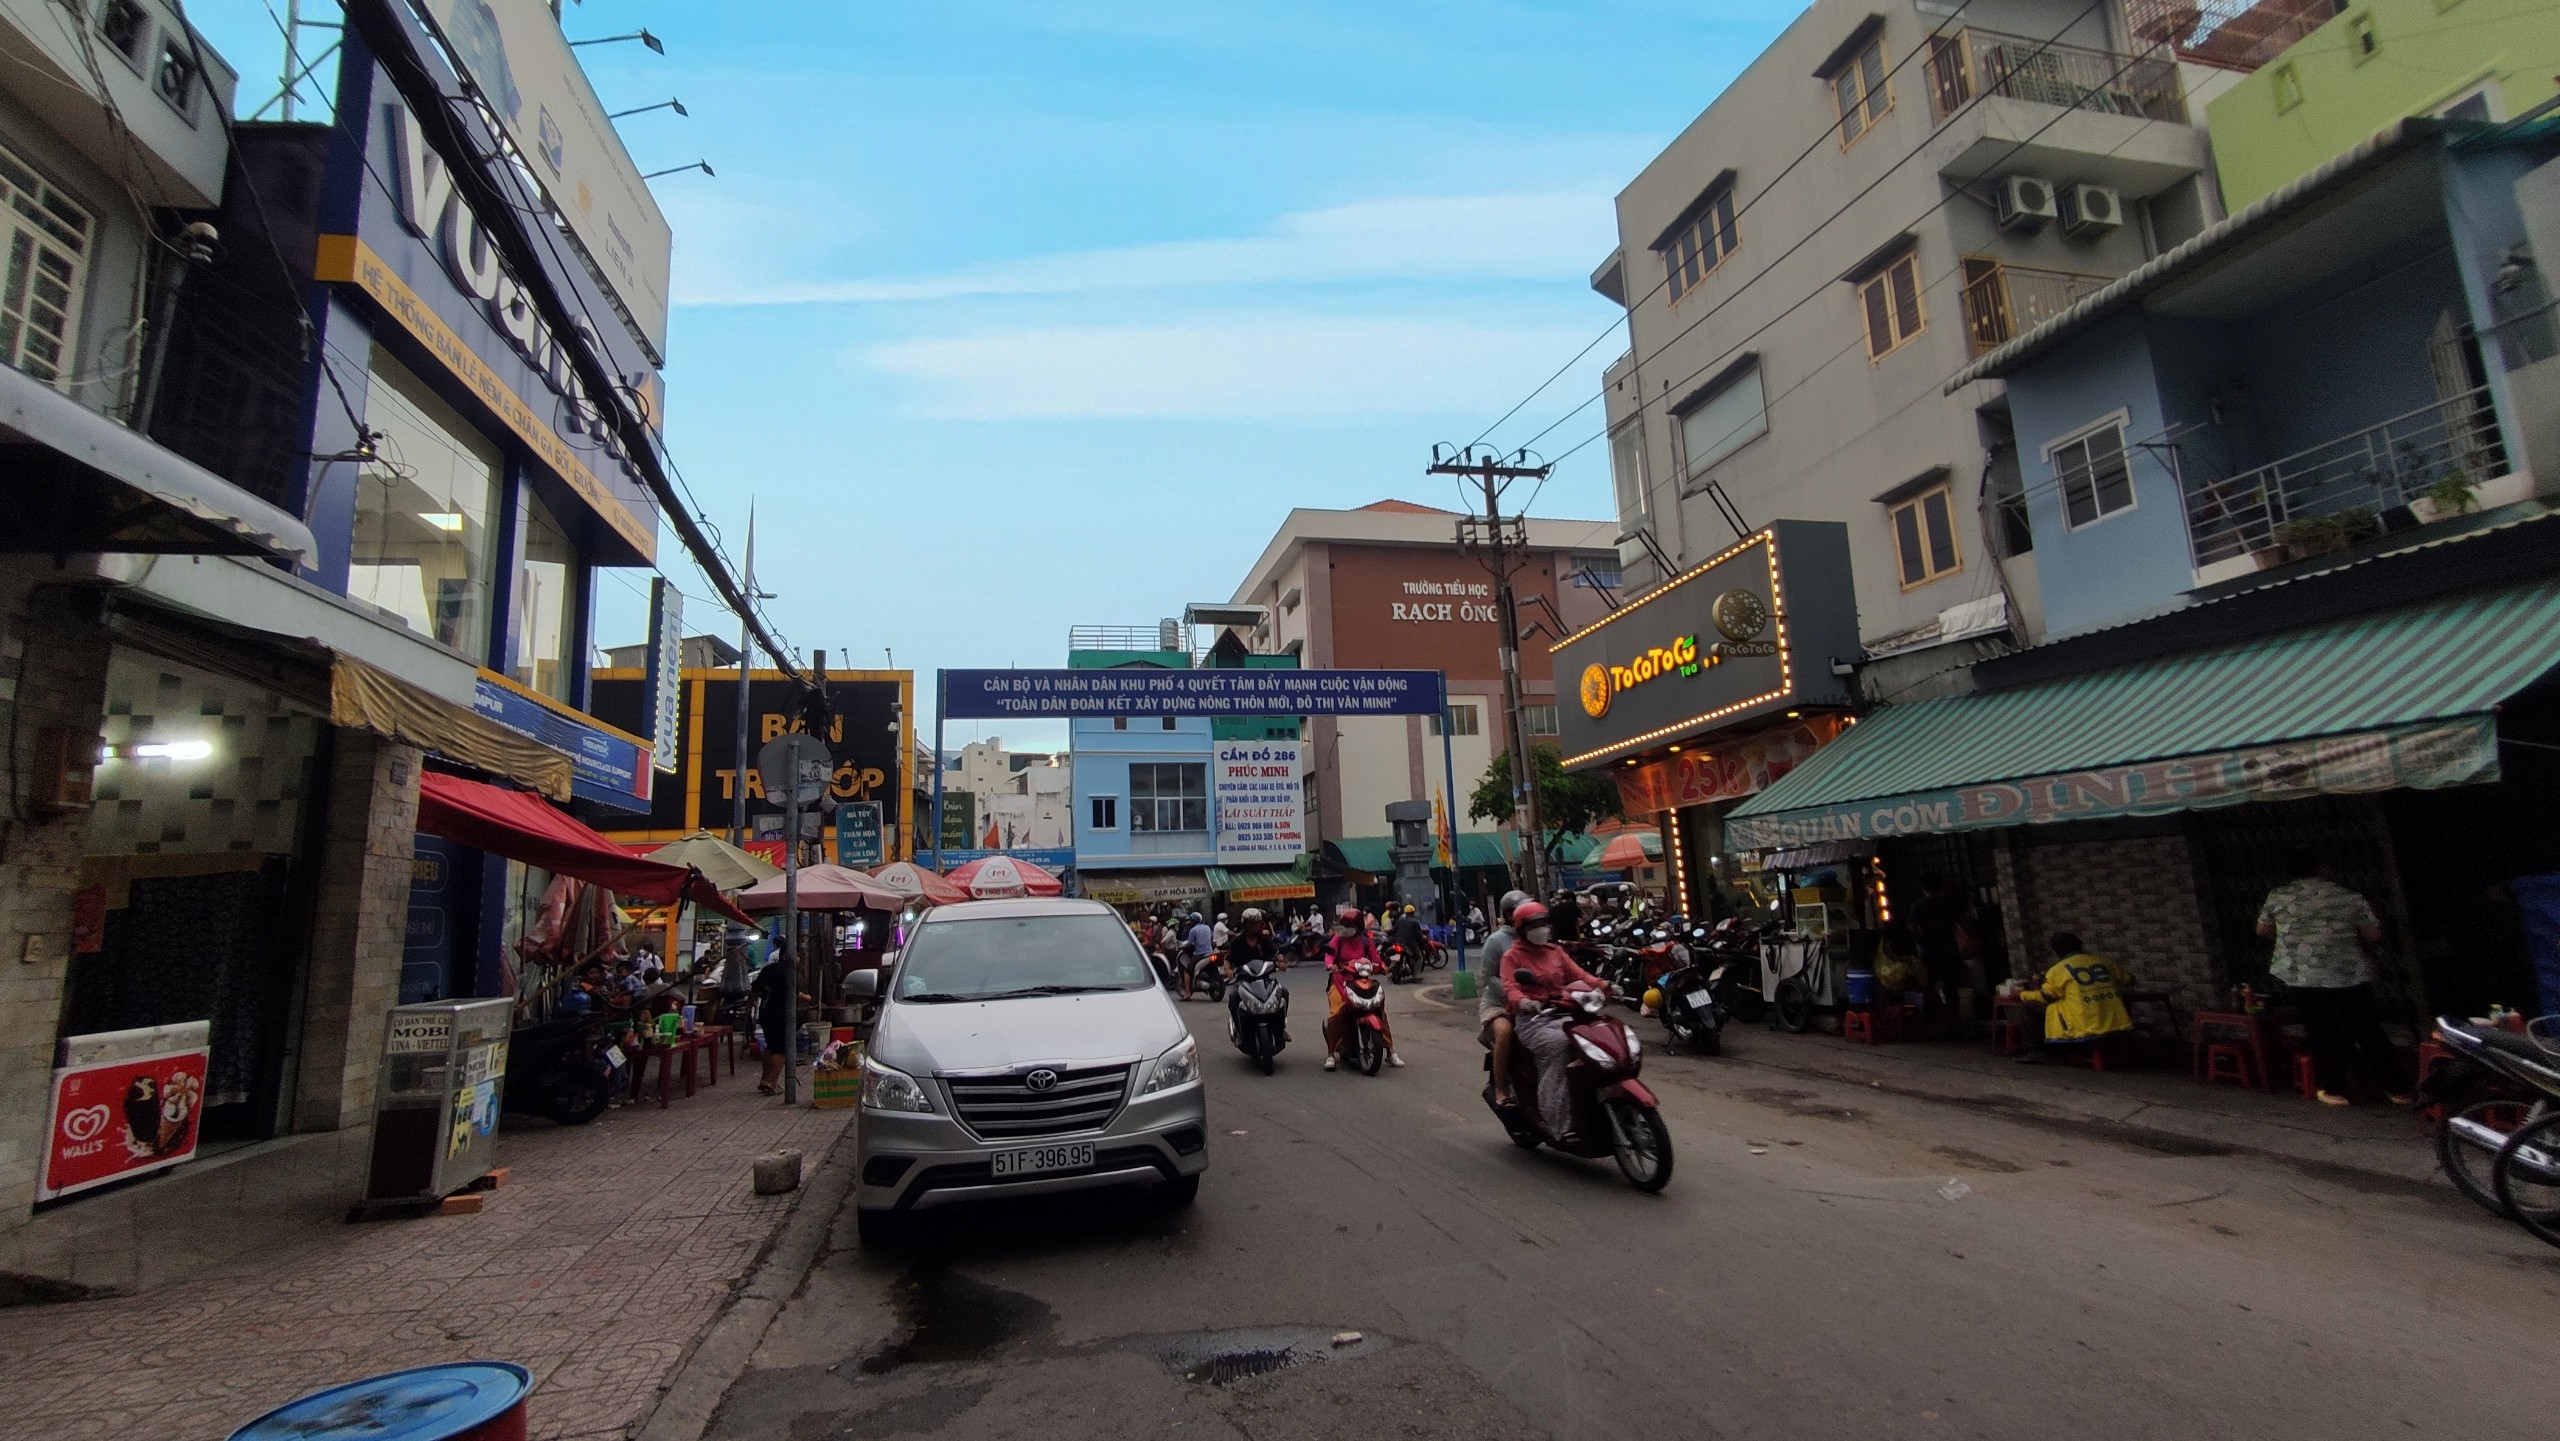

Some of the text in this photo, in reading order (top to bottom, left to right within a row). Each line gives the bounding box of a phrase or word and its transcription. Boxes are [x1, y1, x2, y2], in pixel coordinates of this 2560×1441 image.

[436, 330, 462, 370] BÁN
[1403, 578, 1488, 600] TRƯỜNG TIỂU HỌC
[1391, 600, 1498, 625] RẠCH ÔNG
[1679, 662, 1698, 678] Tea
[984, 673, 1408, 694] CÁN BỘ VÀ NHÂN DÂN KHU PHỐ 4 QUYẾT TÂM ĐẨY MẠNH CUỘC VẬN ĐỘNG
[1041, 696, 1066, 710] DÂN
[1070, 695, 1105, 710] ĐOÀN
[1108, 693, 1131, 710] KẾT
[1135, 695, 1159, 710] XÂY
[1162, 695, 1196, 712] DỰNG
[1199, 695, 1231, 710] NÔNG
[1233, 695, 1265, 710] THÔN
[1268, 694, 1294, 711] MỚI,
[1296, 695, 1313, 710] ĐÔ
[1315, 696, 1334, 712] THỊ
[1337, 695, 1360, 709] VĂN
[662, 695, 675, 758] vua
[1274, 750, 1296, 761] 286
[1228, 763, 1290, 777] PHÚC MINH
[1779, 806, 1862, 845] QUÁN
[1870, 799, 1953, 834] CƠM
[1955, 754, 2238, 824] ĐỊNH
[1243, 805, 1269, 818] SUẤT
[1270, 804, 1296, 818] THẤP
[2064, 963, 2112, 987] be
[392, 1027, 450, 1039] MOBI
[390, 1040, 411, 1052] VINA
[417, 1037, 449, 1051] VIETTEL
[62, 1139, 105, 1161] WALL'S
[995, 1144, 1092, 1174] 51F-396.95
